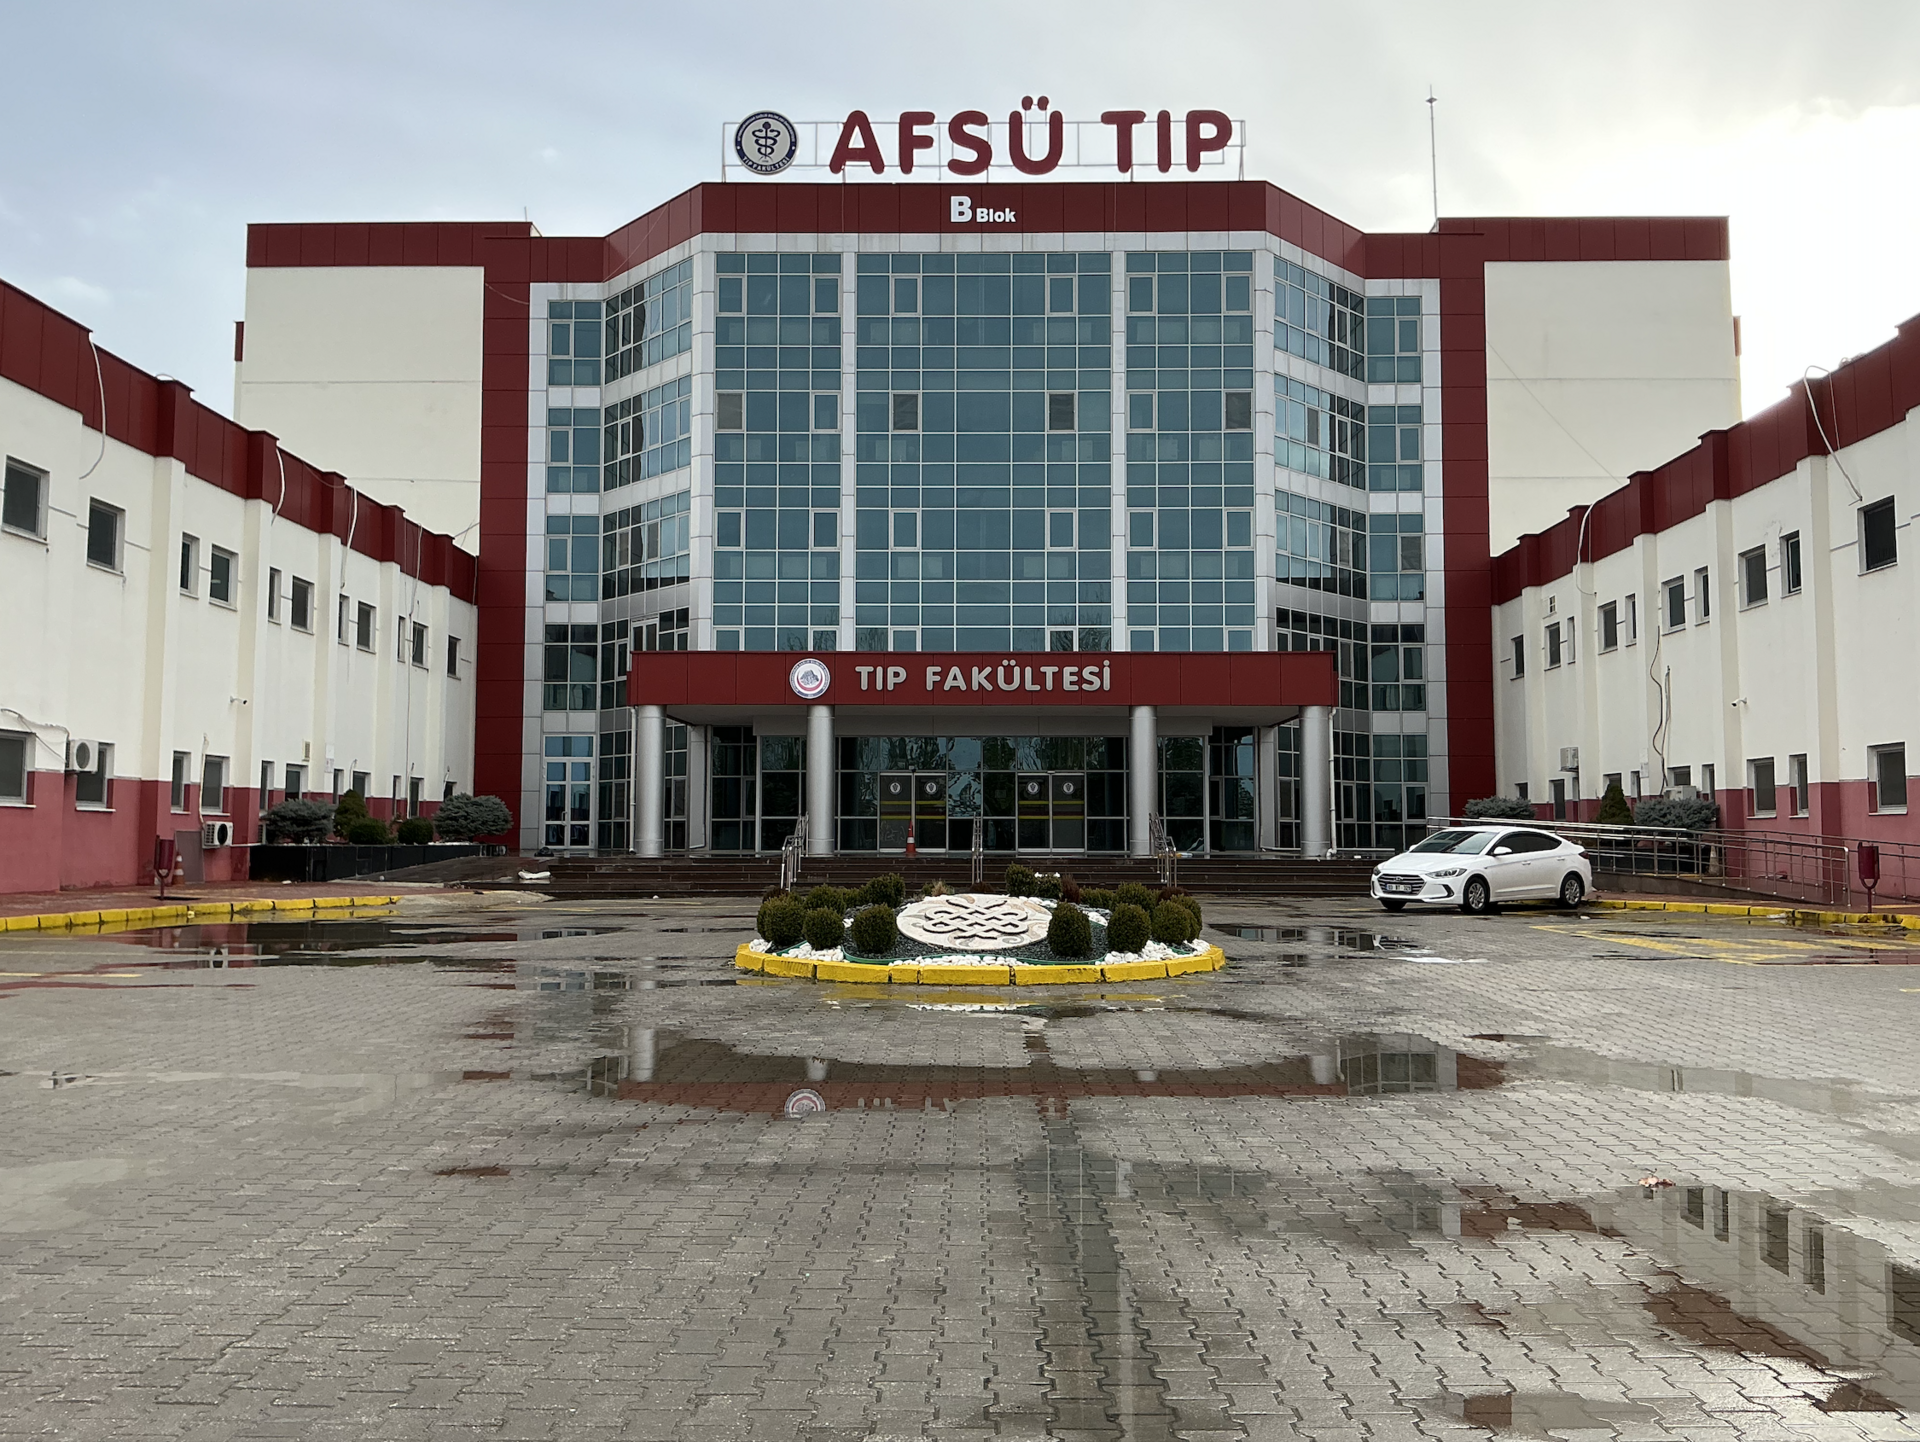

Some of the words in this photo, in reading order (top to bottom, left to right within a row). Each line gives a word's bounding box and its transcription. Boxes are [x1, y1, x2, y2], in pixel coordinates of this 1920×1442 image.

[828, 96, 1064, 176] AFSÜ
[1101, 110, 1233, 173] TIP
[950, 195, 973, 223] B
[976, 207, 1017, 223] Blok
[855, 665, 907, 691] TIP
[925, 659, 1111, 691] FAKÜLTESİ
